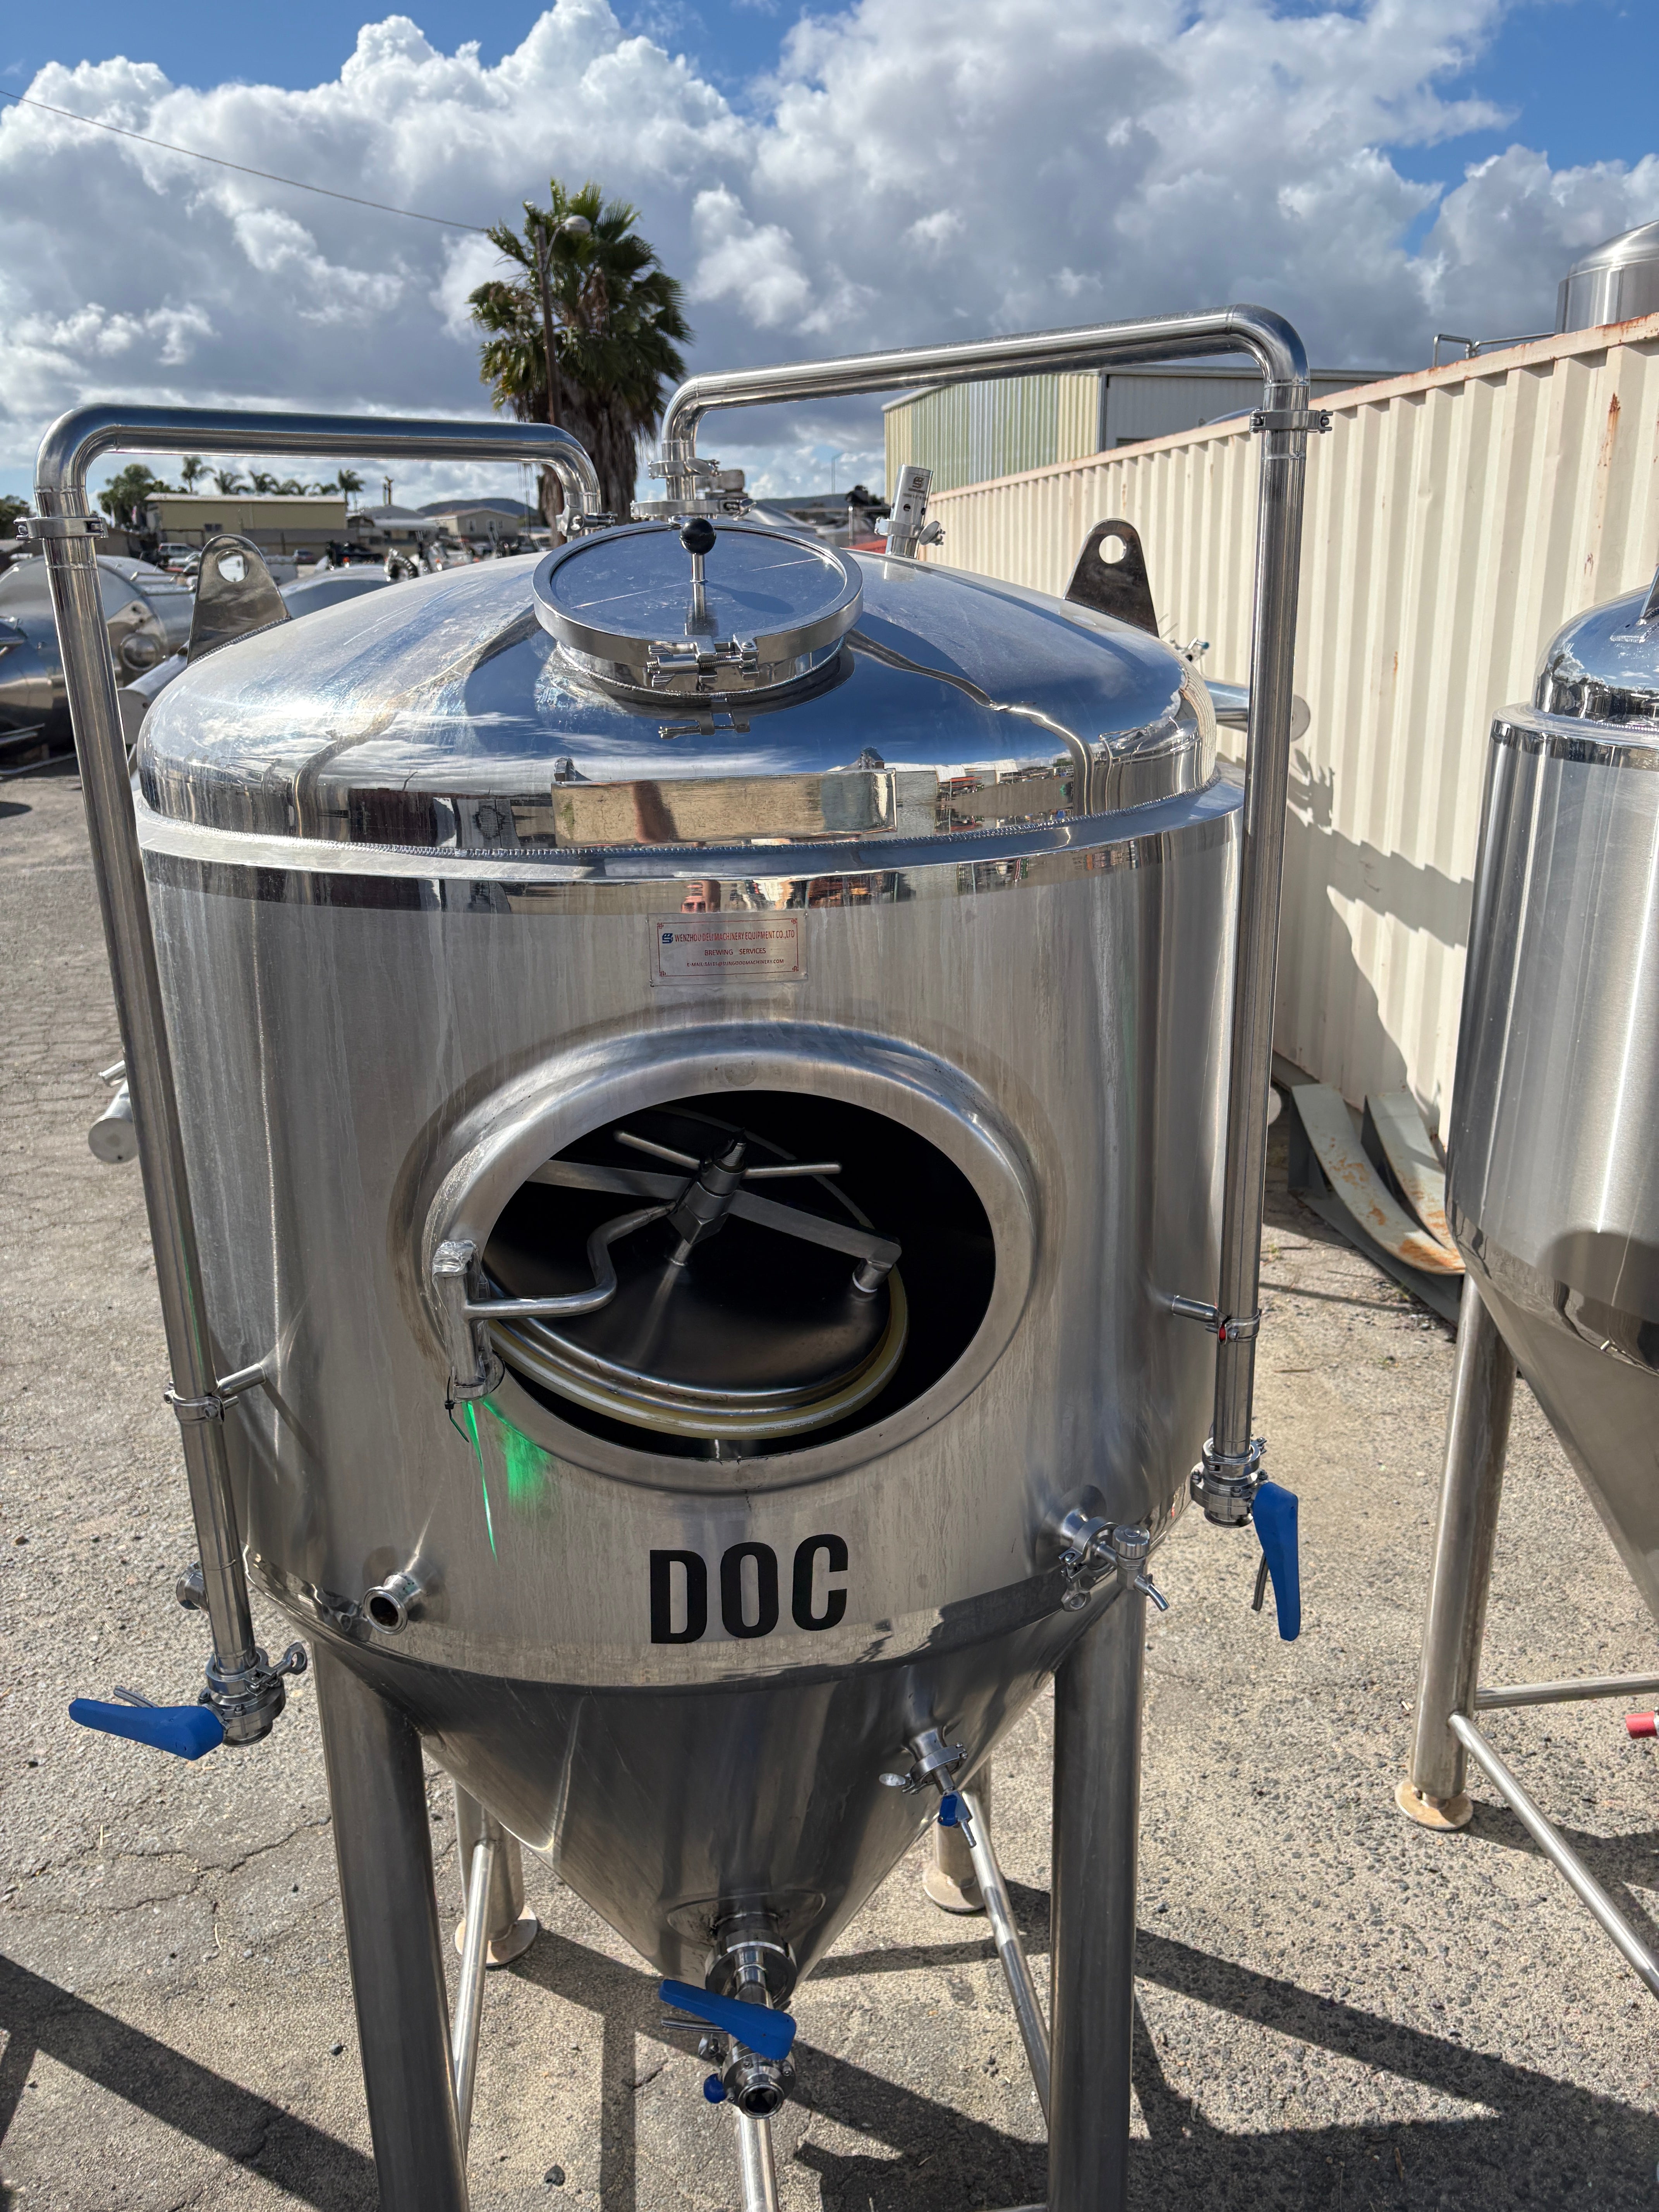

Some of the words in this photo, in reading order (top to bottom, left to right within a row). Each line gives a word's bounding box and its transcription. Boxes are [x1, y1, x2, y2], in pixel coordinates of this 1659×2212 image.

[675, 934, 701, 942] WENZHOU
[714, 932, 744, 941] MACHINERY
[744, 931, 775, 940] EQUIPMENT
[649, 1534, 848, 1644] DOC
